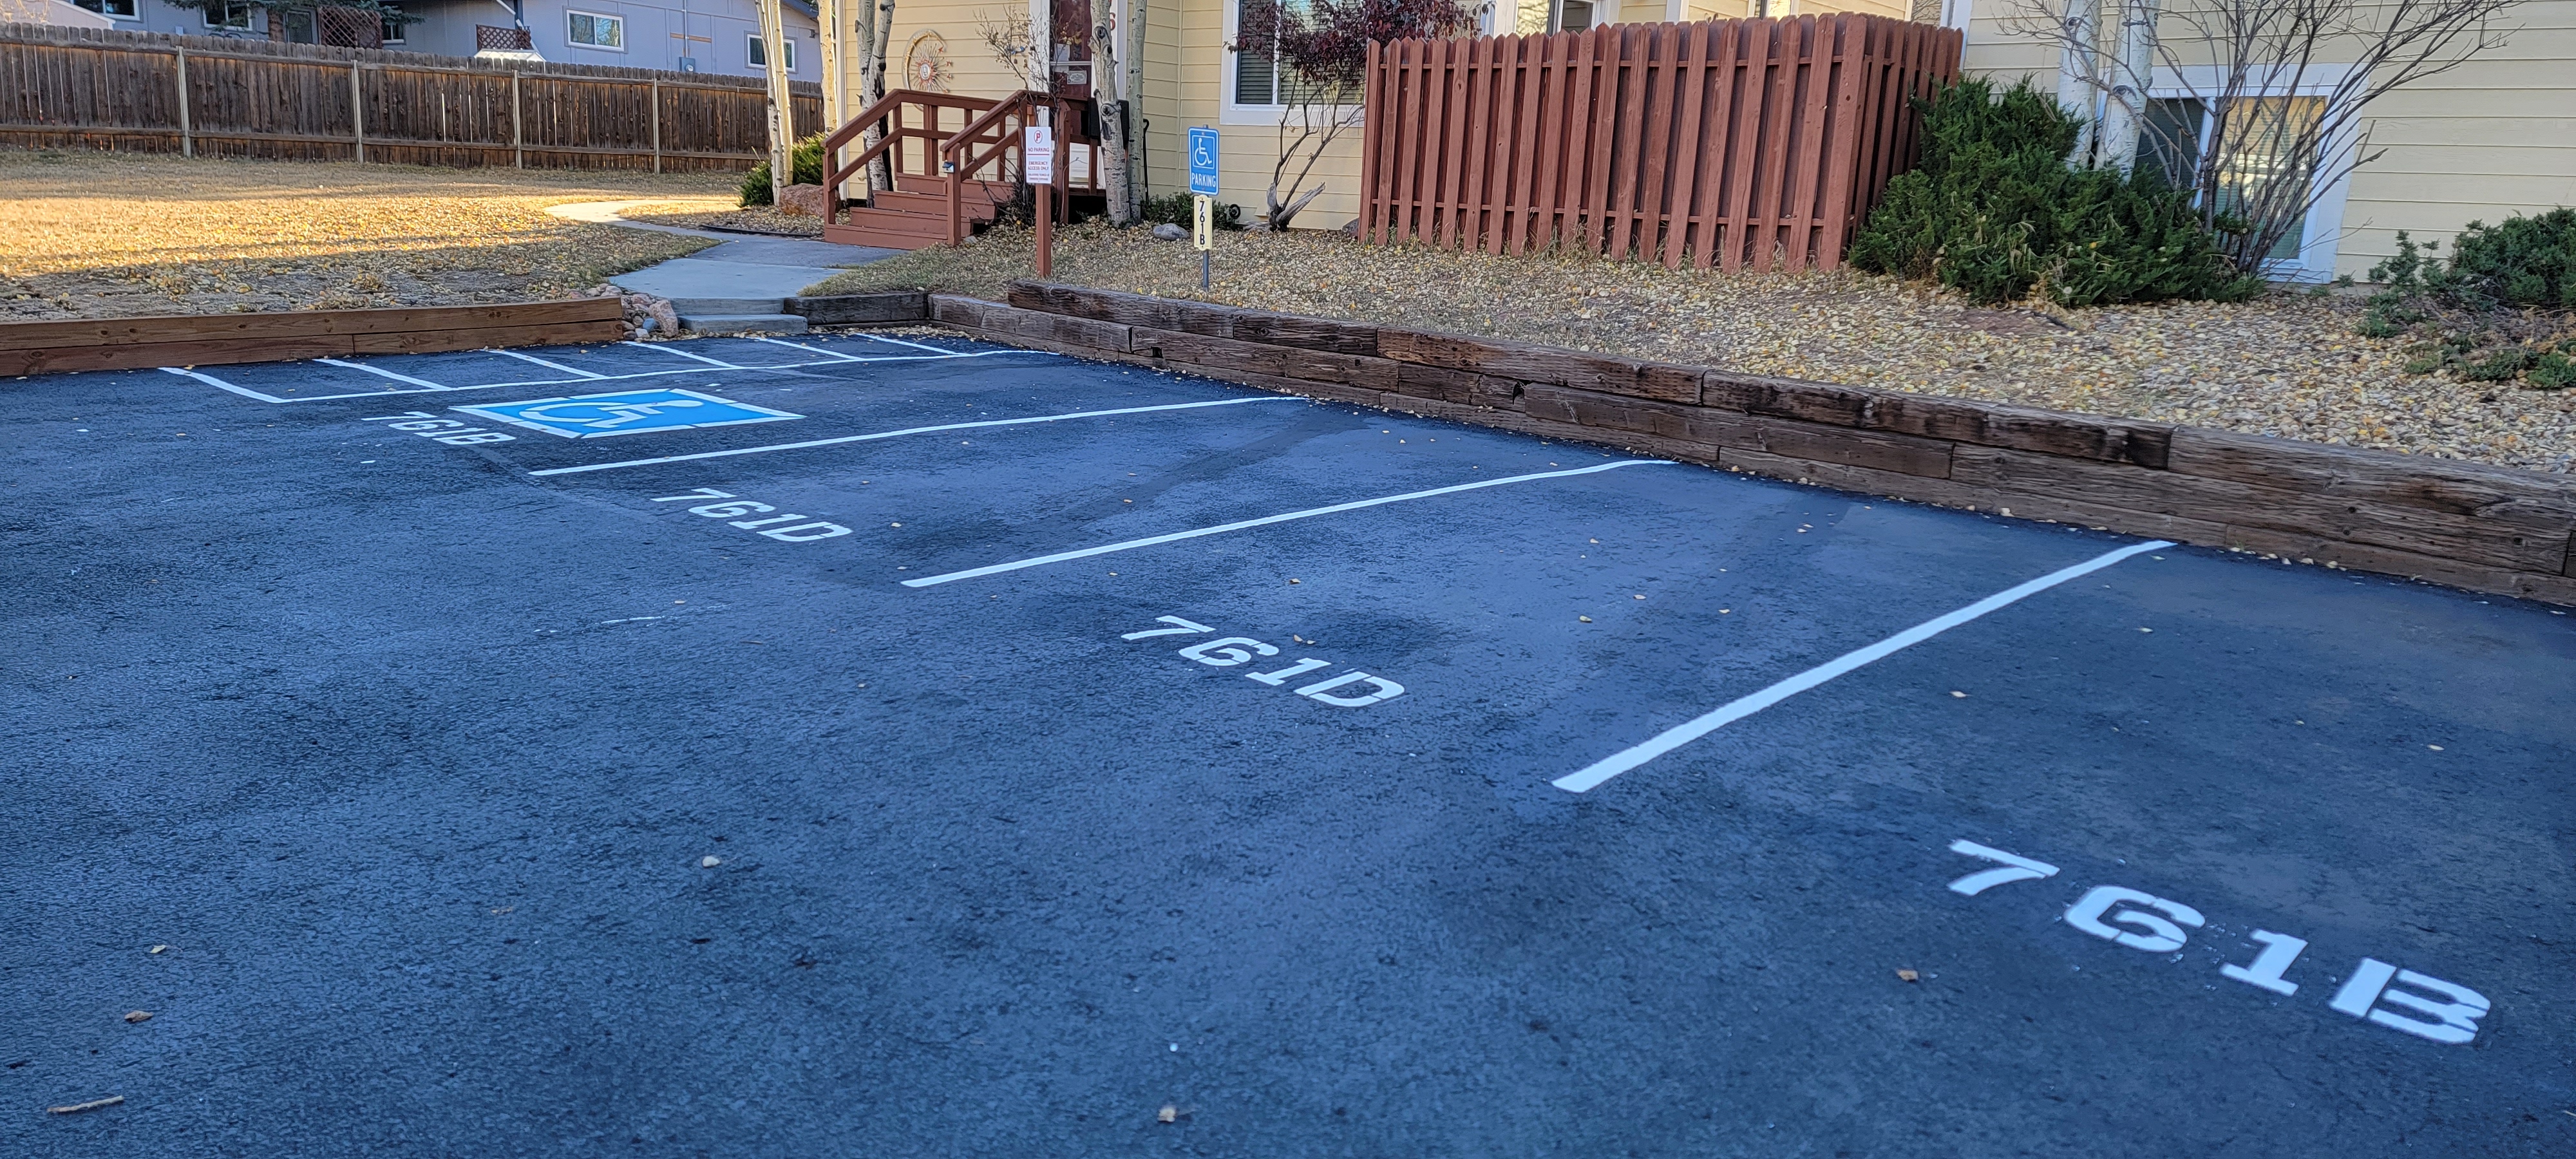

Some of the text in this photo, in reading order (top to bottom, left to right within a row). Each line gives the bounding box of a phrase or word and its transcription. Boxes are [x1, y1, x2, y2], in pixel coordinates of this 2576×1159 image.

[1191, 172, 1216, 187] PARKING
[361, 411, 516, 445] 761B
[650, 487, 853, 542] 761D
[1121, 615, 1405, 707] 761D
[1947, 838, 2491, 1044] 761B
